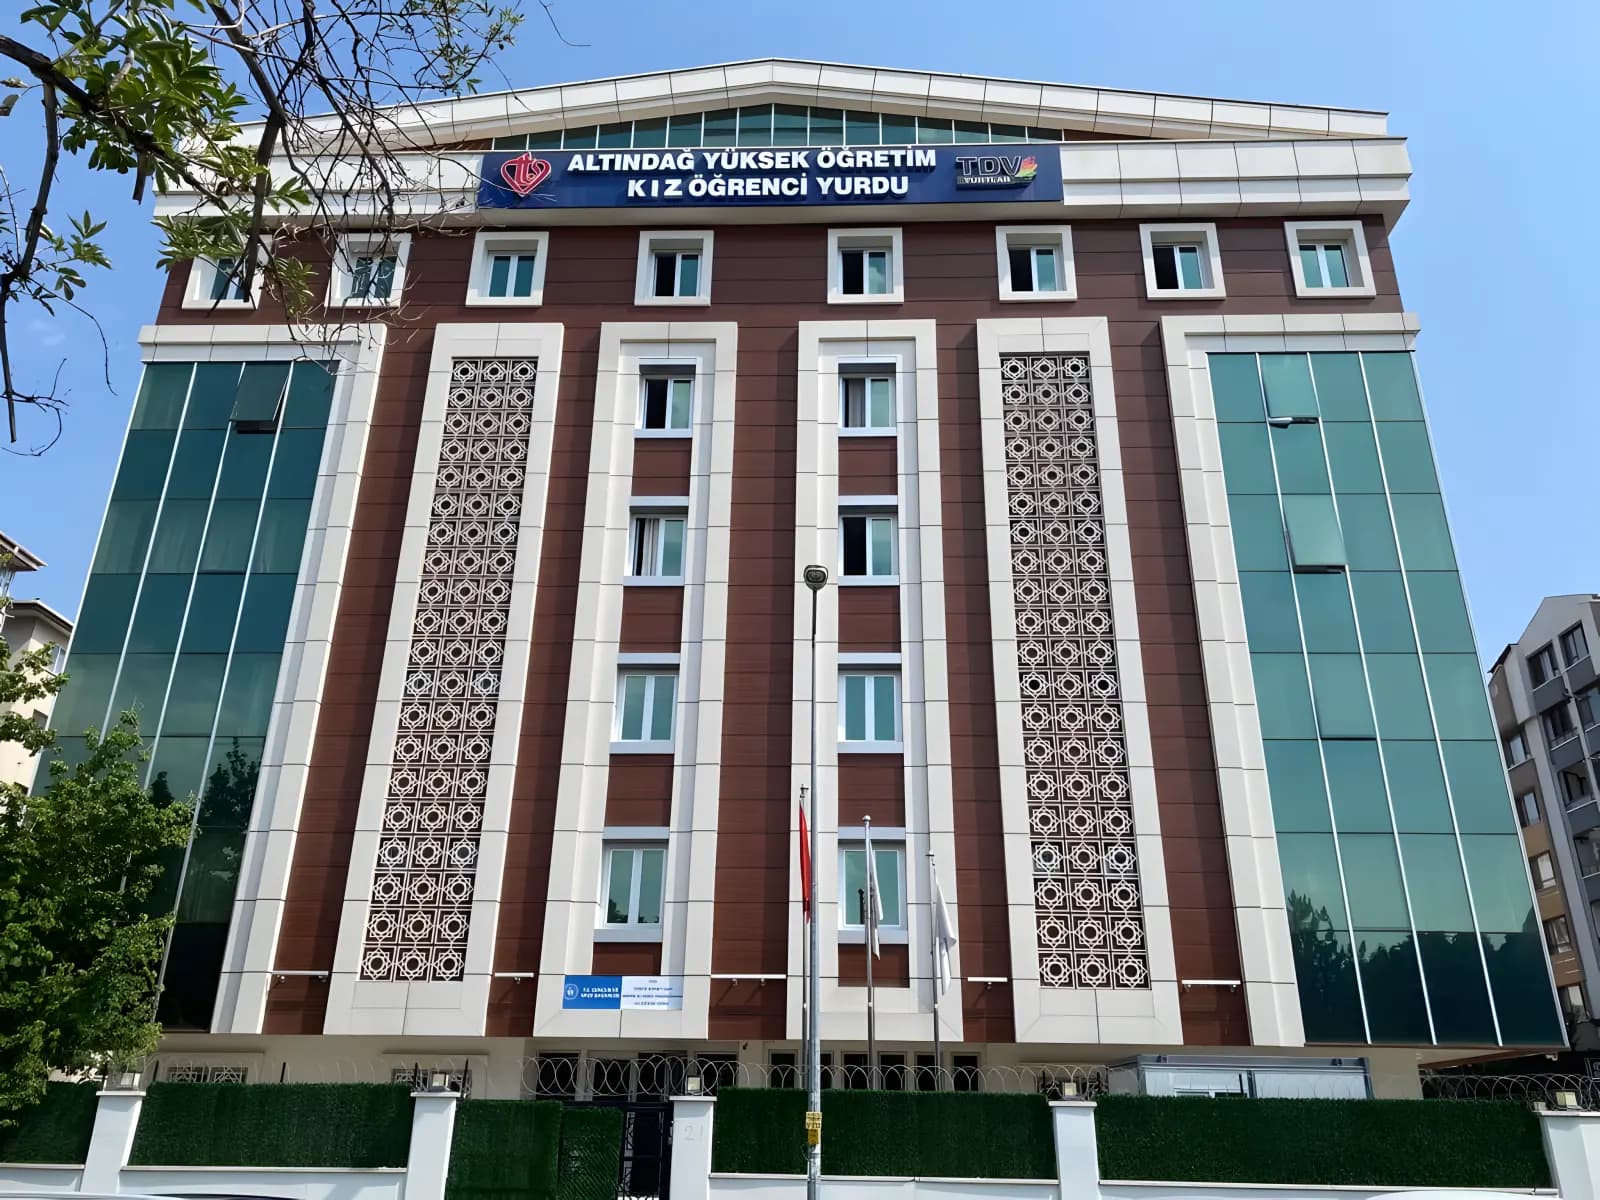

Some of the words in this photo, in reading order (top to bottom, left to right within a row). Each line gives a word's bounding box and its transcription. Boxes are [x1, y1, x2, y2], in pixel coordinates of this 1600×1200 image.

[568, 149, 694, 171] ALTINDAĞ
[703, 148, 809, 170] YÜKSEK
[817, 145, 937, 168] ÖĞRETİM
[956, 155, 1022, 176] TDV
[627, 178, 683, 198] KIZ
[688, 173, 808, 197] ÖĞRENCİ
[816, 176, 909, 196] YURDU
